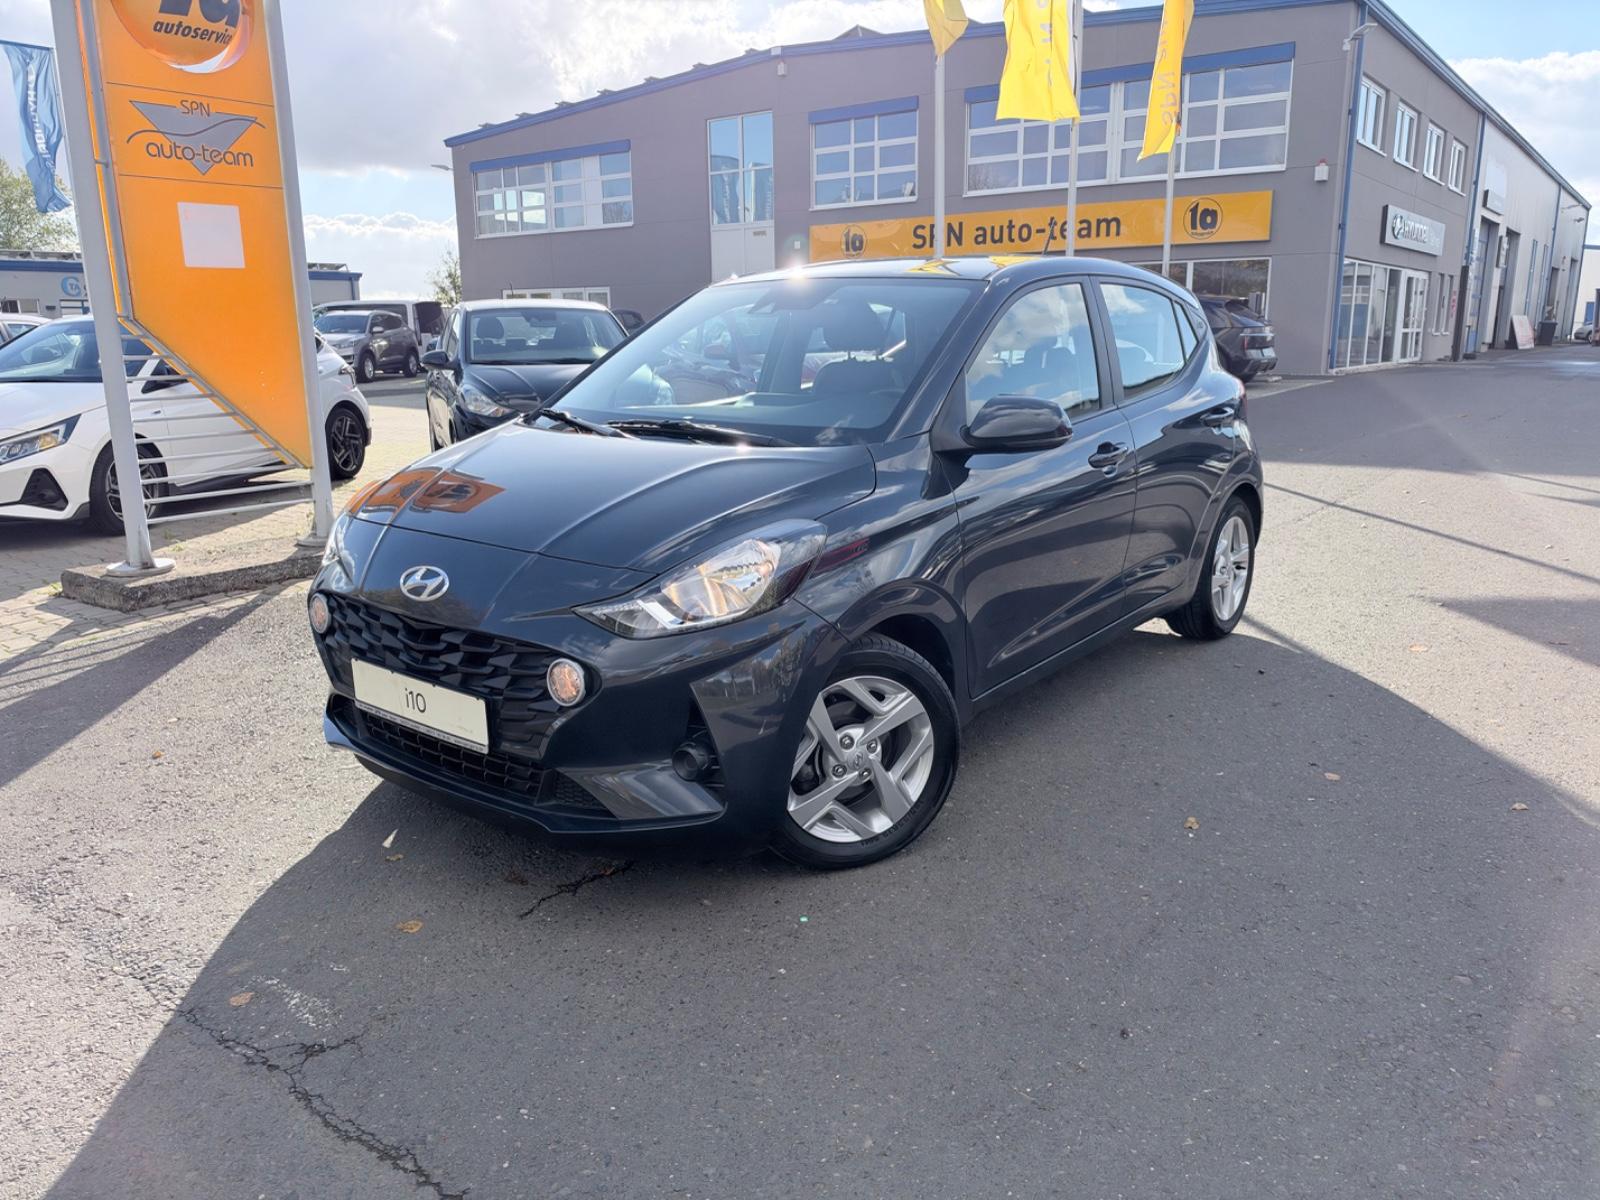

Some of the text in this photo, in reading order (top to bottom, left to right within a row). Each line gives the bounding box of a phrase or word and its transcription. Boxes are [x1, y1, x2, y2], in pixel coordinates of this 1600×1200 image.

[180, 99, 211, 117] SPN
[146, 141, 254, 167] auto-team
[405, 687, 427, 713] i10
